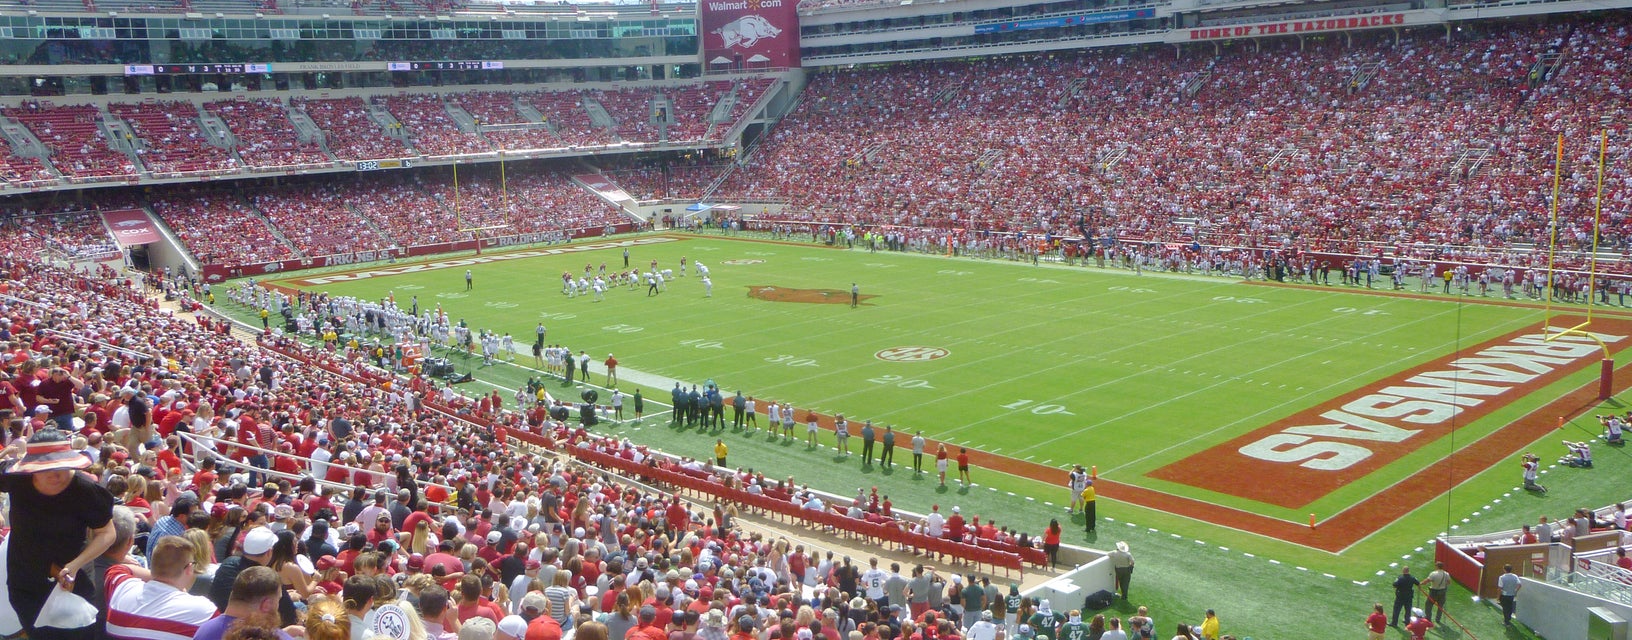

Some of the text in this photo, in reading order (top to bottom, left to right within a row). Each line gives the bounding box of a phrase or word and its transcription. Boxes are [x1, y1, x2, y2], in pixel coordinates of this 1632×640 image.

[709, 0, 747, 11] Walmart
[1190, 13, 1405, 39] HOME OF THE RAZORBACKS
[121, 227, 149, 235] COX
[764, 354, 815, 367] 30
[866, 374, 929, 389] 20
[1238, 325, 1630, 471] ARKANSAS
[1000, 399, 1067, 415] 10
[871, 578, 880, 588] 6
[1008, 599, 1021, 608] 32
[1041, 616, 1055, 628] 47
[1069, 630, 1084, 640] 47
